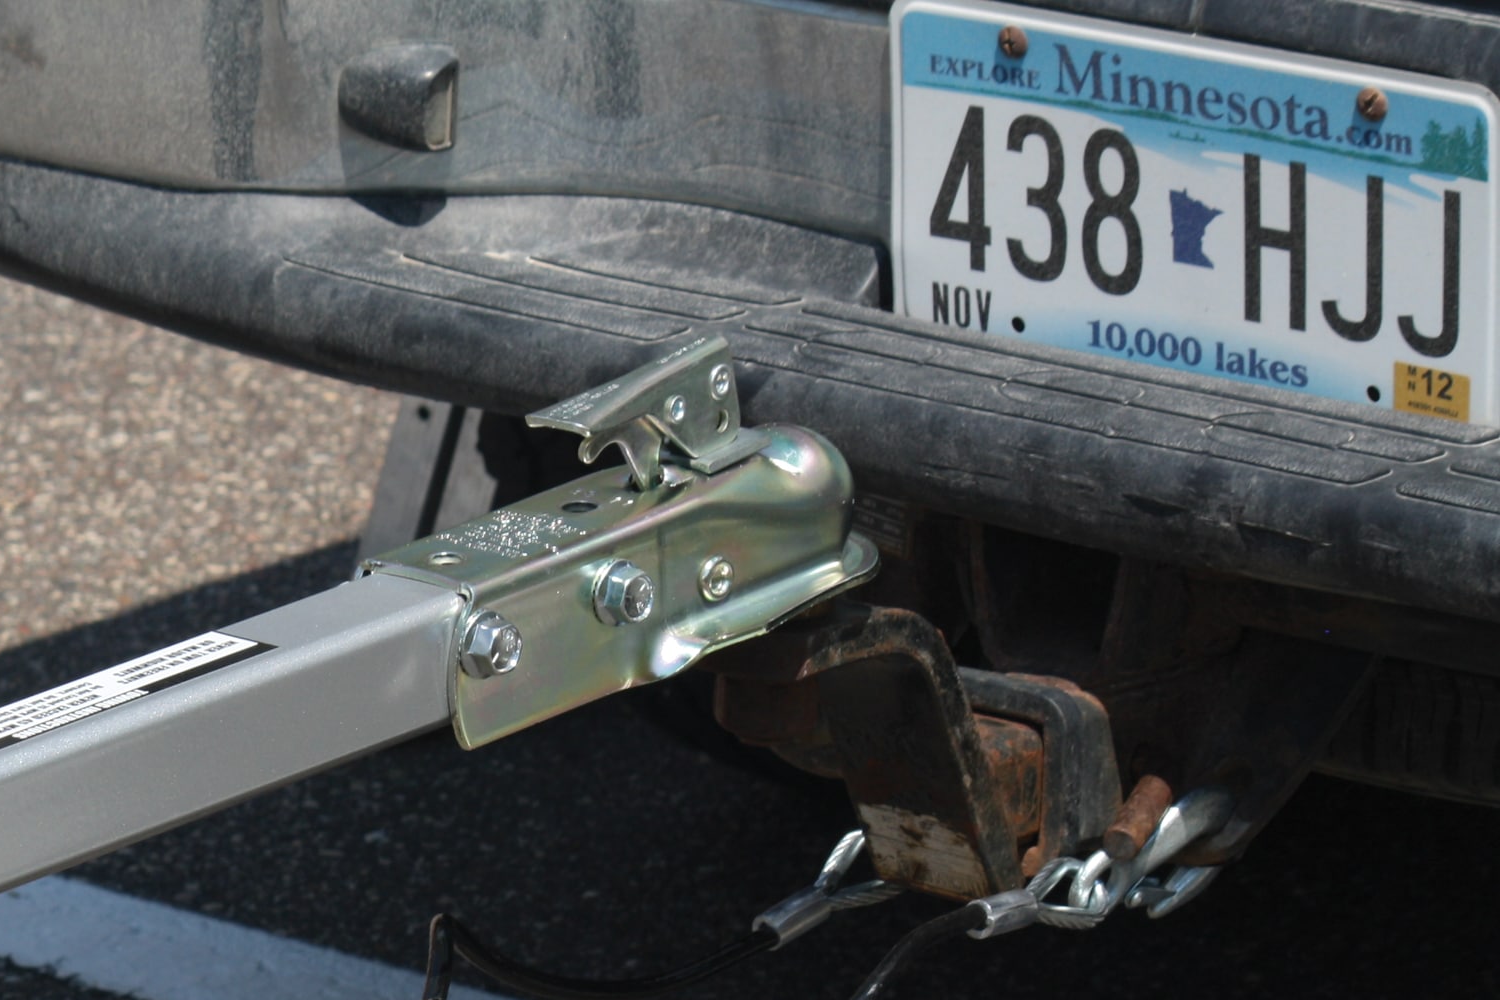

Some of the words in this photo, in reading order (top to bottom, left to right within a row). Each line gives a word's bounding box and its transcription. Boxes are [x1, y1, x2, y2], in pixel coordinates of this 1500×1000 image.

[930, 54, 1041, 91] EXPLORE
[1054, 43, 1413, 155] Minnesota.com
[930, 105, 1143, 295] 438
[1244, 152, 1461, 357] HJJ
[932, 282, 992, 333] NOV
[1088, 319, 1201, 366] 10,000
[1217, 339, 1309, 389] lakes
[1421, 369, 1453, 401] 12
